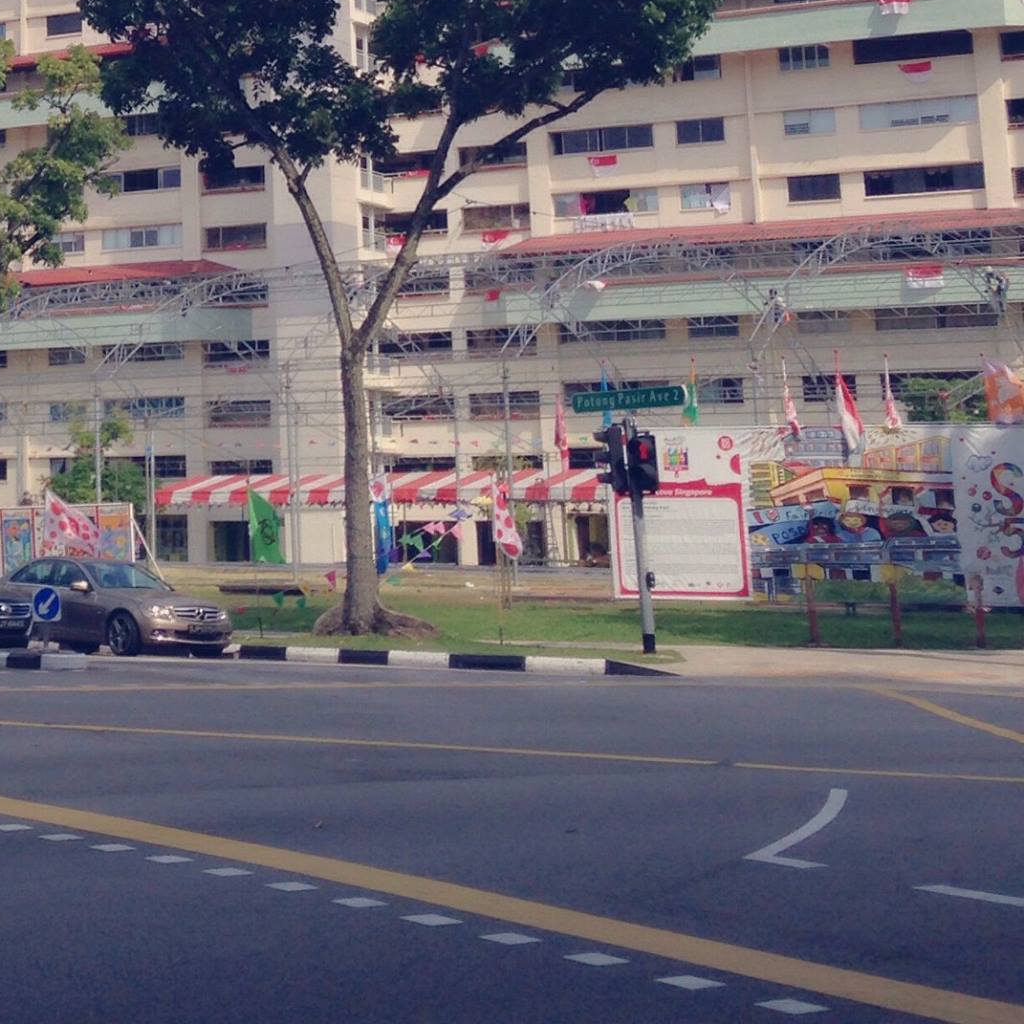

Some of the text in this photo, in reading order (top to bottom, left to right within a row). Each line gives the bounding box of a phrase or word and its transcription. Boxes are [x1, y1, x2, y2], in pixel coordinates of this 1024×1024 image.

[577, 389, 680, 409] Potong Pasir Ave 2
